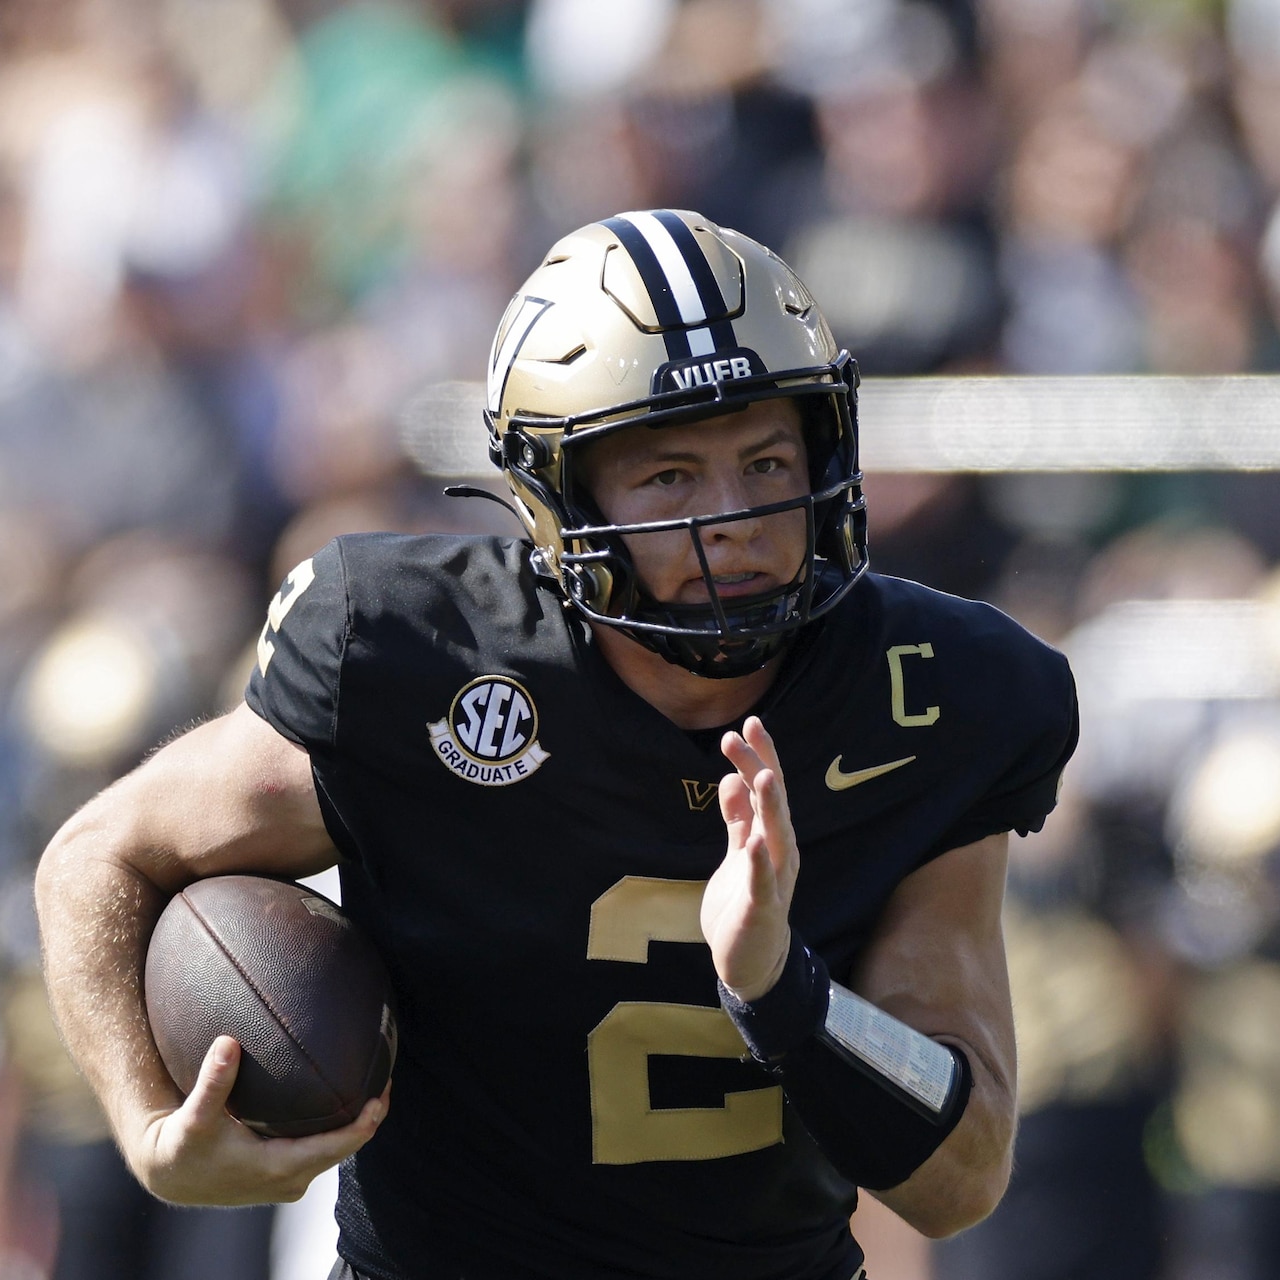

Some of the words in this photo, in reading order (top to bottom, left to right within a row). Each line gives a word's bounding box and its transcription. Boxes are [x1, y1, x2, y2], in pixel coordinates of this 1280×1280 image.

[671, 357, 752, 389] VUFB
[456, 683, 531, 757] SEC
[886, 642, 941, 727] C
[438, 741, 528, 782] GRADUATE
[586, 875, 785, 1165] 2
